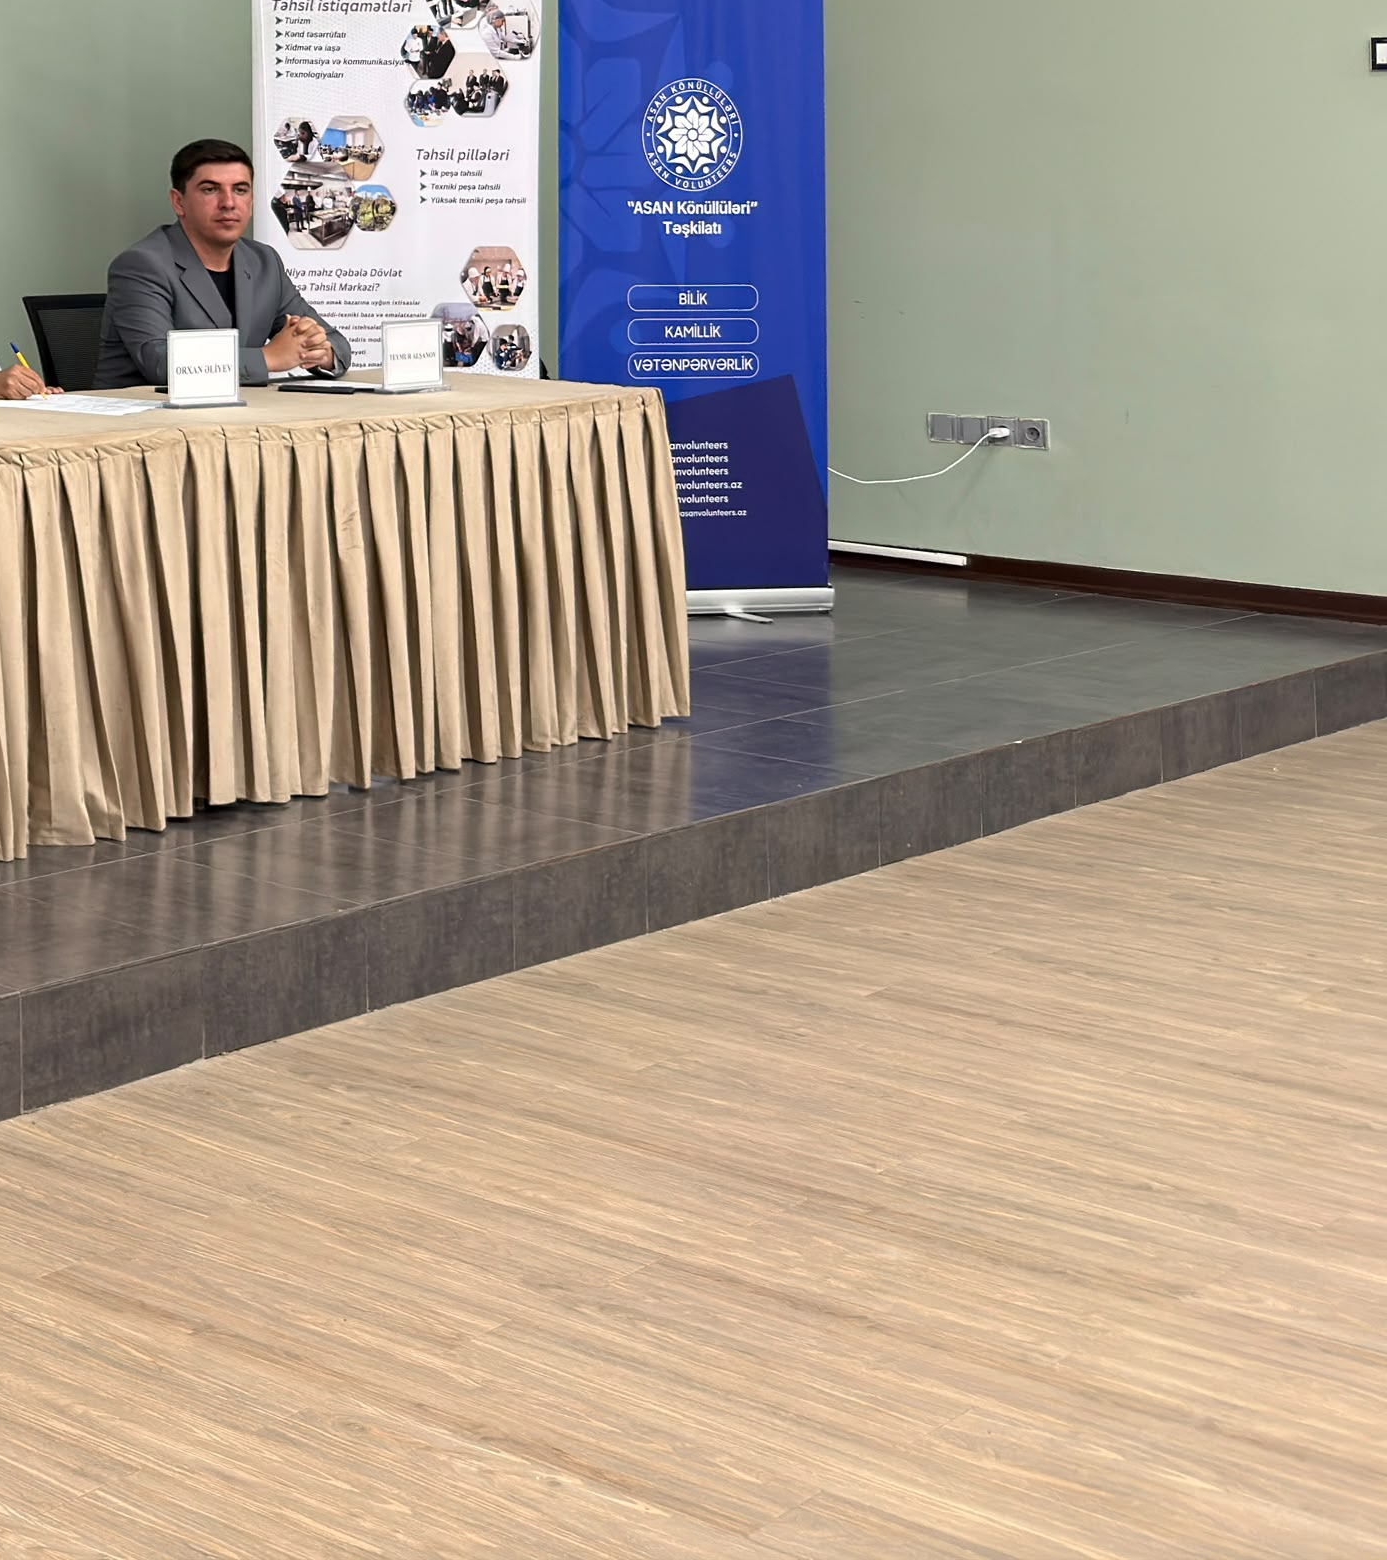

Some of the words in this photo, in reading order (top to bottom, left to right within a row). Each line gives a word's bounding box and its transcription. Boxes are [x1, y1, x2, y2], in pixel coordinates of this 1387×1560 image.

[317, 0, 413, 15] istiqamətləri
[284, 16, 311, 25] Turizm
[284, 30, 305, 38] Kənd
[284, 43, 312, 51] Xidmət
[342, 57, 405, 67] kommunikasiya
[647, 93, 667, 123] ASAN
[416, 148, 454, 161] Təhsil
[457, 148, 510, 164] pillələri
[460, 169, 483, 177] təhsili
[647, 152, 670, 180] ASAN
[675, 151, 737, 190] VOLUNTEERS
[431, 183, 457, 191] Texniki
[477, 183, 501, 191] təhsili
[458, 196, 484, 204] texniki
[662, 221, 722, 238] Təşkilatı
[286, 268, 306, 279] Niyə
[307, 268, 334, 277] məhz
[335, 267, 368, 279] Qəbələ
[370, 268, 403, 278] Dövlət
[309, 282, 337, 292] Təhsil
[338, 282, 381, 292] Mərkəzi?
[678, 289, 708, 305] BİLİK
[664, 322, 721, 338] KAMİLLİK
[175, 365, 203, 376] ORXAN
[204, 363, 233, 374] ƏLİYEV
[633, 355, 754, 372] VƏTƏNPƏRVƏRLİK
